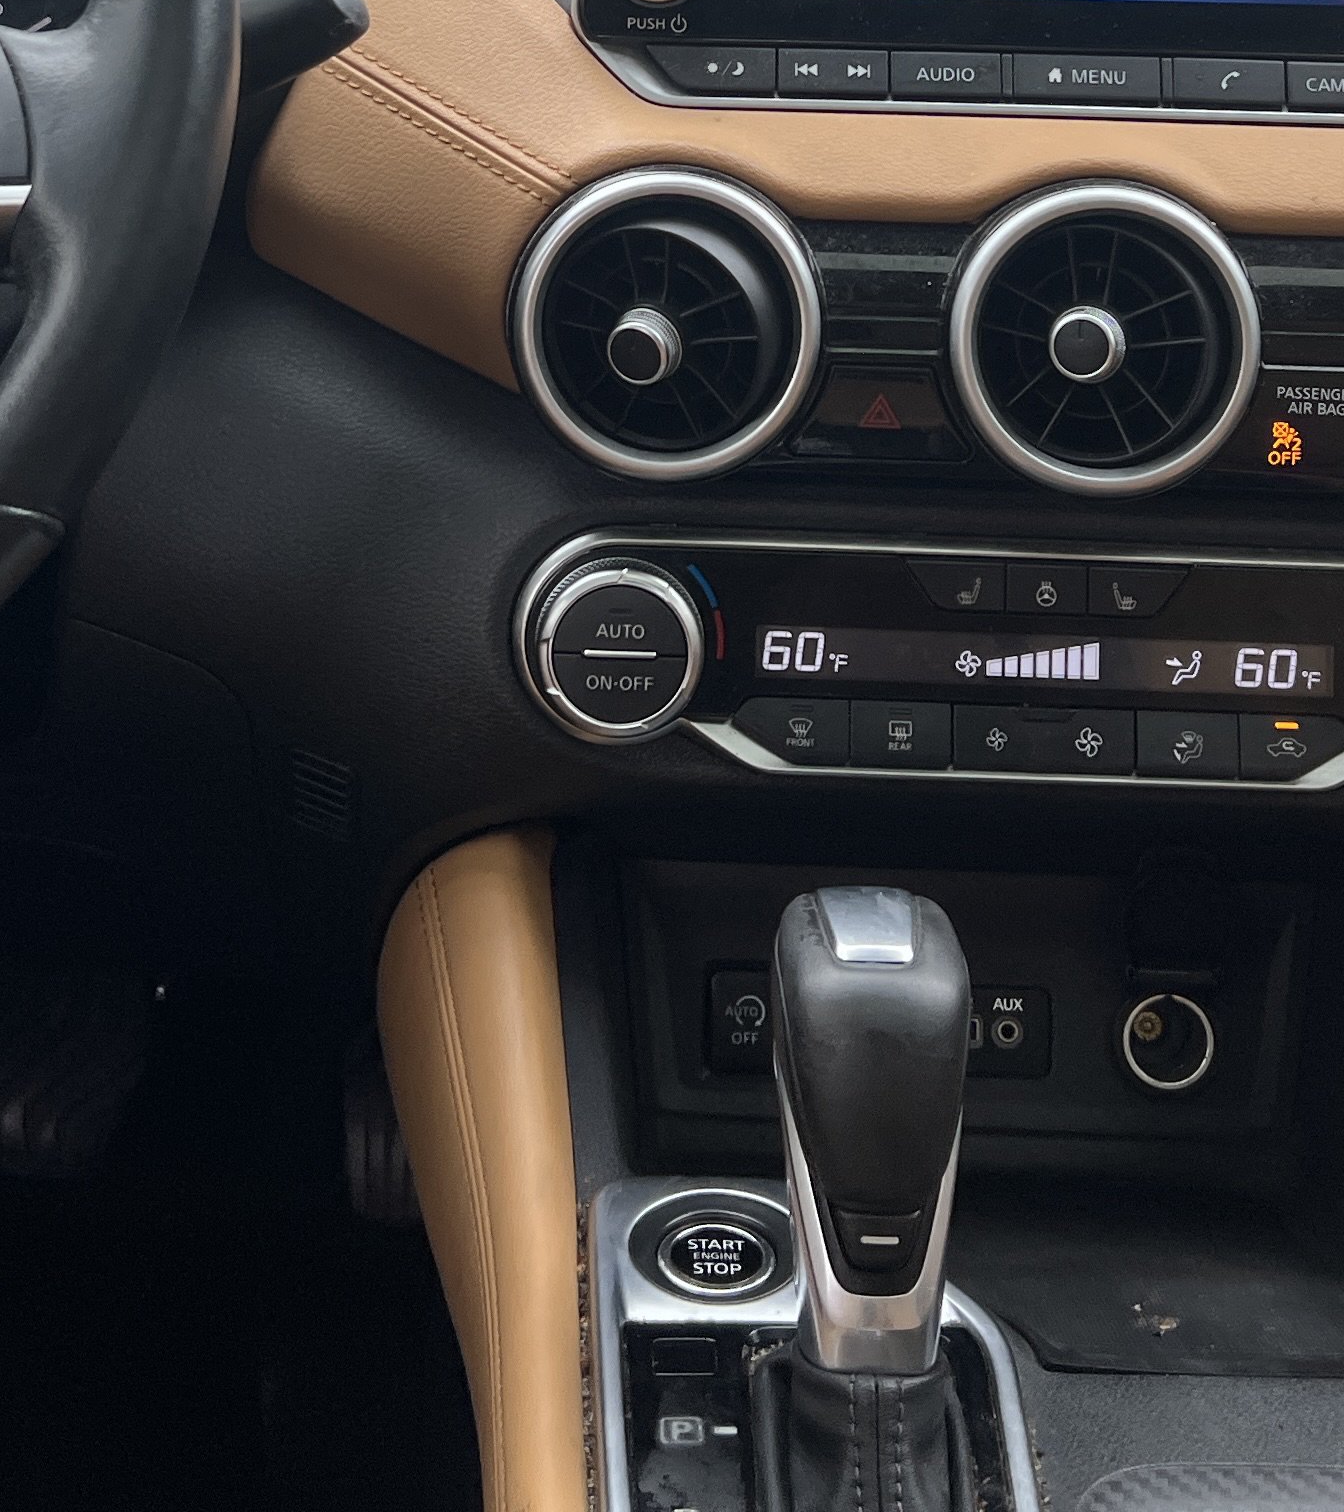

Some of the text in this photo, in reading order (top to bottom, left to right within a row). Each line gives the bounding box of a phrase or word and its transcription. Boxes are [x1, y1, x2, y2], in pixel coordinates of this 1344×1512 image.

[626, 16, 667, 31] PUSH
[916, 66, 976, 82] AUDIO
[1071, 69, 1127, 85] MENU
[1287, 401, 1313, 415] AIR
[1267, 450, 1302, 466] OFF
[595, 624, 646, 640] AUTO
[785, 737, 815, 749] FRONT
[887, 740, 913, 752] REAR
[992, 997, 1024, 1012] AUX
[731, 1030, 759, 1045] OFF
[687, 1238, 746, 1253] START
[693, 1251, 741, 1262] ENGINE
[692, 1261, 743, 1277] STOP
[670, 1420, 694, 1441] P
